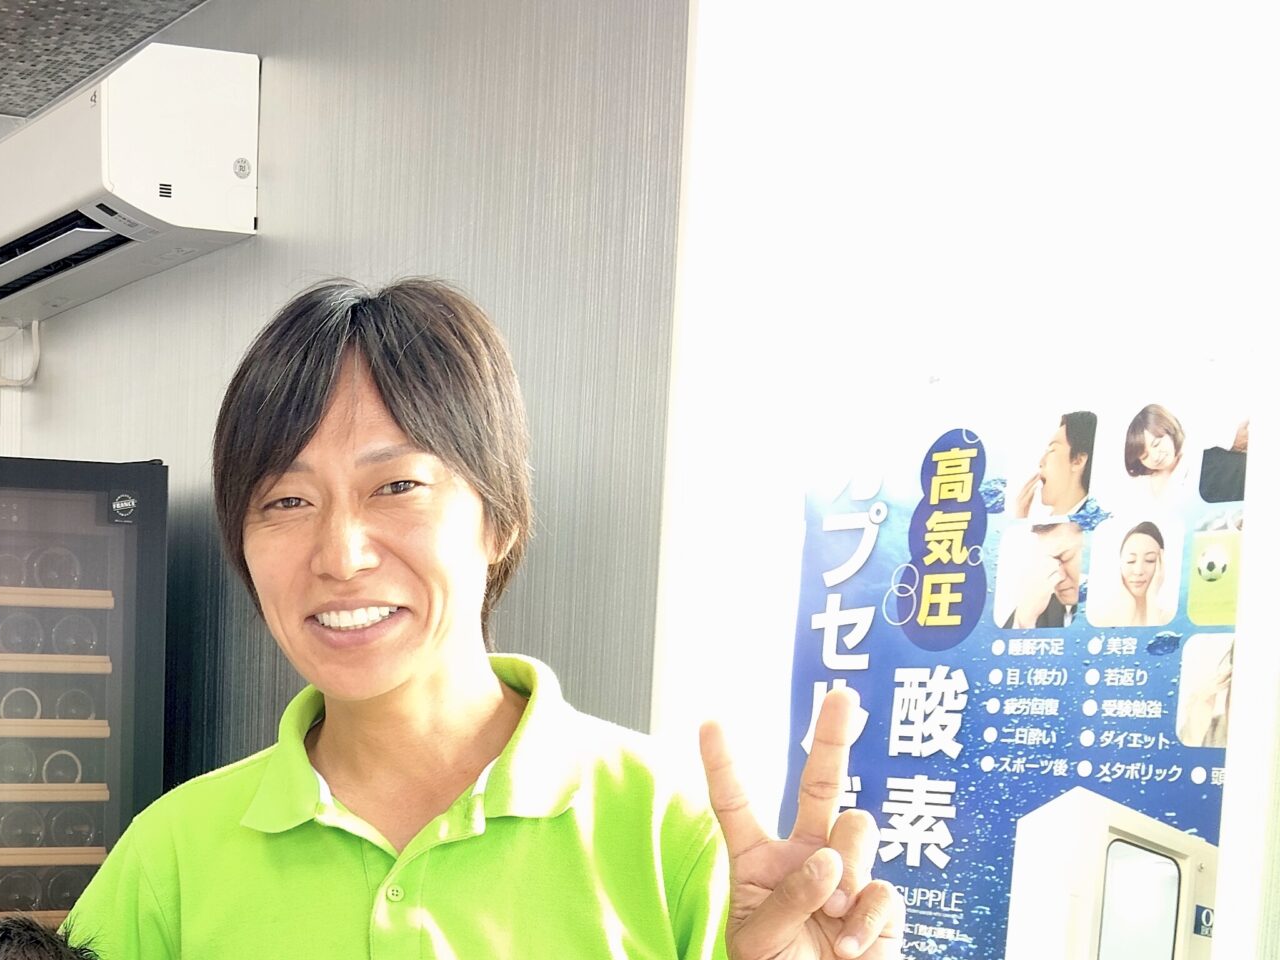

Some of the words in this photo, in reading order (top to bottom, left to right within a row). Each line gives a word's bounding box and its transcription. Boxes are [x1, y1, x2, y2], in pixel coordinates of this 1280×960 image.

[916, 446, 978, 628] 高気圧
[1008, 638, 1065, 656] 睡眠不足
[1106, 637, 1138, 655] 美容
[1104, 668, 1149, 686] 若返り
[1003, 698, 1060, 716] 疲労回復
[1101, 700, 1162, 718] 受験勉強
[1001, 727, 1057, 745] 二日酔い
[1099, 731, 1170, 750] ダイエット
[878, 664, 970, 870] 酸素
[998, 756, 1069, 777] スポーツ後
[1096, 761, 1183, 782] メタボリック
